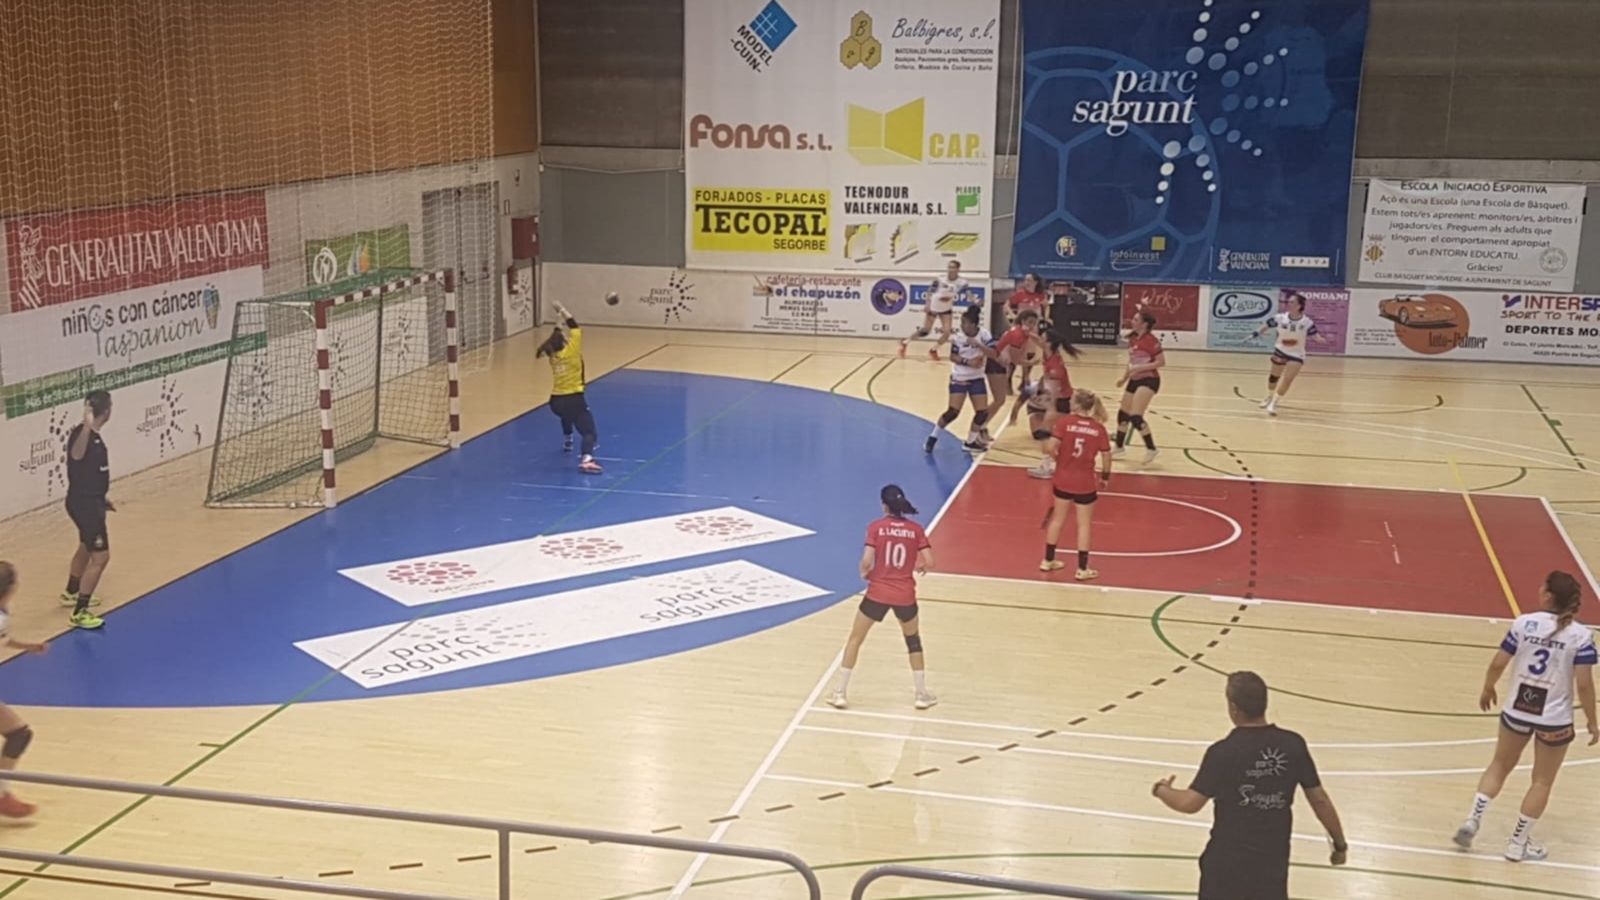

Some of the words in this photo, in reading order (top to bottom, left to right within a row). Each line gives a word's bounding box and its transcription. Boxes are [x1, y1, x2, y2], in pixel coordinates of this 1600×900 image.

[892, 18, 965, 45] Balbigres,
[737, 24, 773, 66] MODEL
[1110, 70, 1198, 105] parc
[1072, 94, 1198, 136] sagunt
[796, 133, 832, 151] S.L.
[929, 133, 980, 159] CAP
[695, 190, 763, 203] FORJADOS
[775, 192, 826, 205] PLACAS
[844, 186, 909, 199] TECNODUR
[1483, 199, 1512, 207] Escola
[1513, 200, 1525, 208] de
[844, 202, 923, 216] VALENCIANA,
[926, 203, 947, 216] S.L.
[1371, 208, 1398, 216] Estem
[1446, 223, 1488, 232] Preguem
[45, 229, 163, 287] GENERALITAT
[165, 216, 263, 267] VALENCIANA
[773, 239, 826, 250] SEGORBE
[1391, 233, 1426, 243] tinguen
[1430, 235, 1439, 243] el
[1441, 236, 1509, 246] comportament
[1510, 239, 1551, 248] apropiat
[1430, 248, 1468, 257] ENTORN
[776, 286, 787, 297] el
[791, 286, 861, 300] chapuzón
[118, 303, 147, 325] con
[152, 290, 202, 317] cáncer
[1218, 294, 1265, 316] Sugars
[1500, 310, 1540, 319] SPORT
[1544, 311, 1562, 320] TO
[1566, 312, 1591, 321] THE
[104, 314, 205, 363] aspanion
[1505, 325, 1574, 336] DEPORTES
[1578, 328, 1600, 337] MO
[1072, 438, 1085, 458] 5
[885, 541, 906, 569] 10
[640, 594, 756, 622] sagunt
[655, 586, 732, 608] parc
[389, 635, 479, 661] parc
[361, 644, 500, 679] sagunt
[1528, 649, 1550, 675] 3
